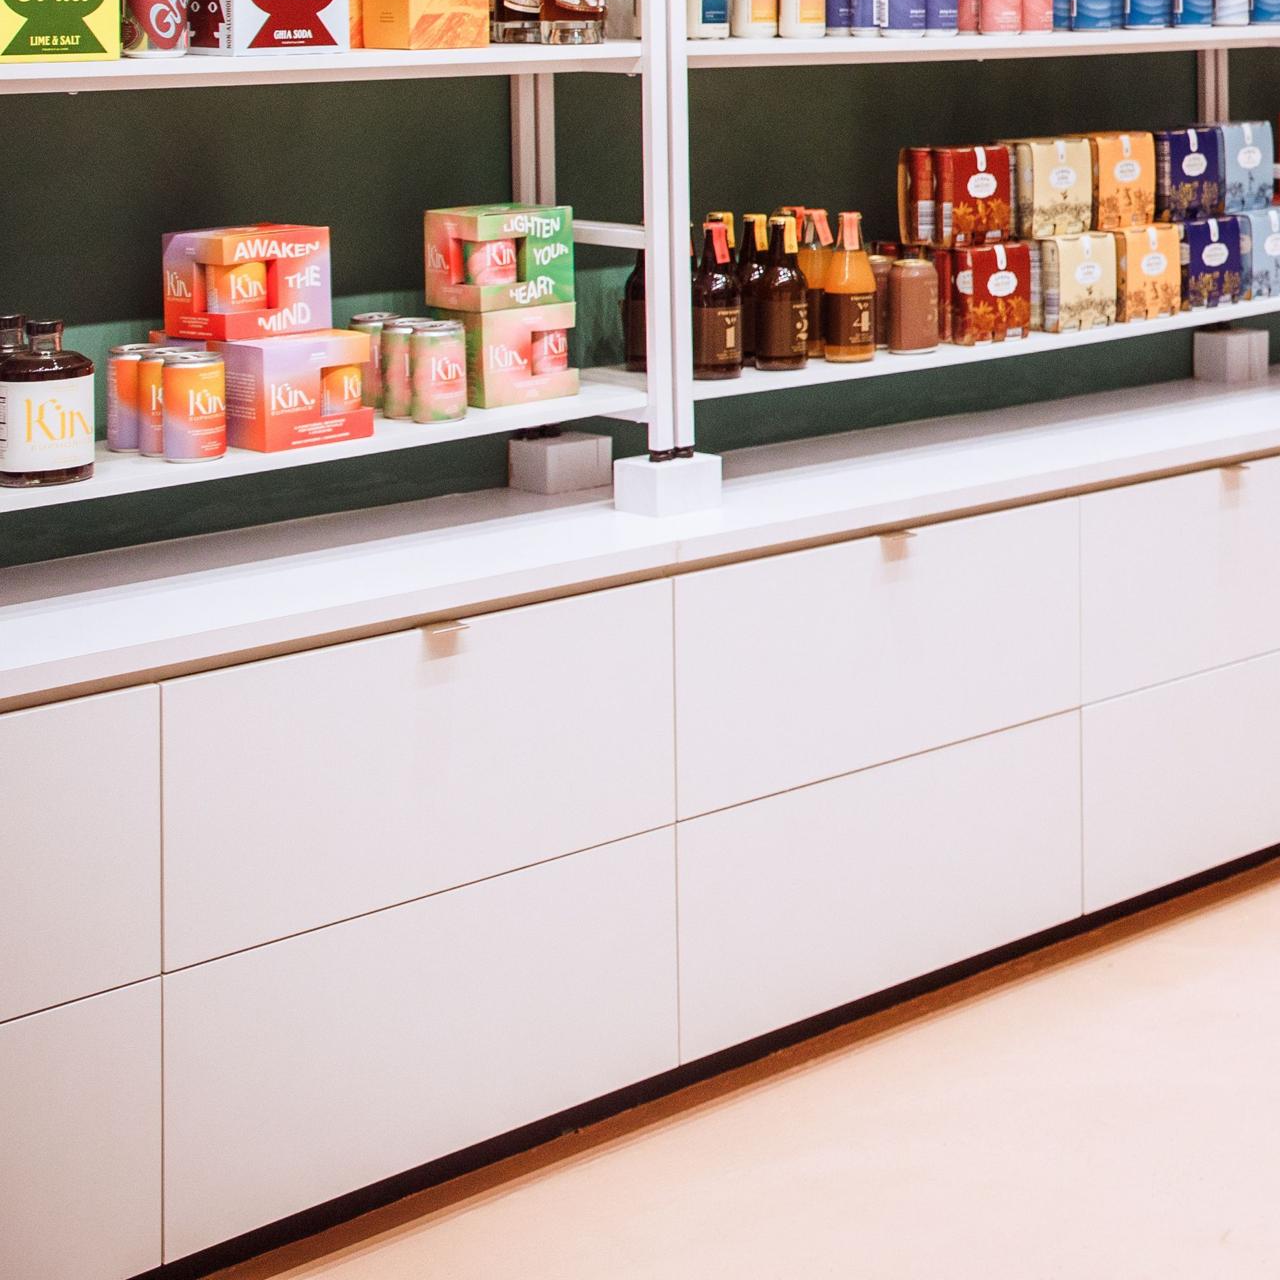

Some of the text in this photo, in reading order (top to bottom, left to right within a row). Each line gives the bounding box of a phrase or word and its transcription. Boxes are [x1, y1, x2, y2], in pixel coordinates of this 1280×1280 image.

[30, 36, 50, 46] LIME
[60, 35, 80, 45] SALT
[503, 215, 560, 239] LIGHTEN
[233, 240, 320, 261] AWAKEN
[532, 242, 569, 266] YOUR
[284, 264, 321, 288] THE
[509, 275, 556, 304] HEART
[258, 302, 311, 331] MIND
[431, 356, 465, 381] Kin
[188, 389, 225, 416] Kin
[24, 398, 92, 444] Kin
